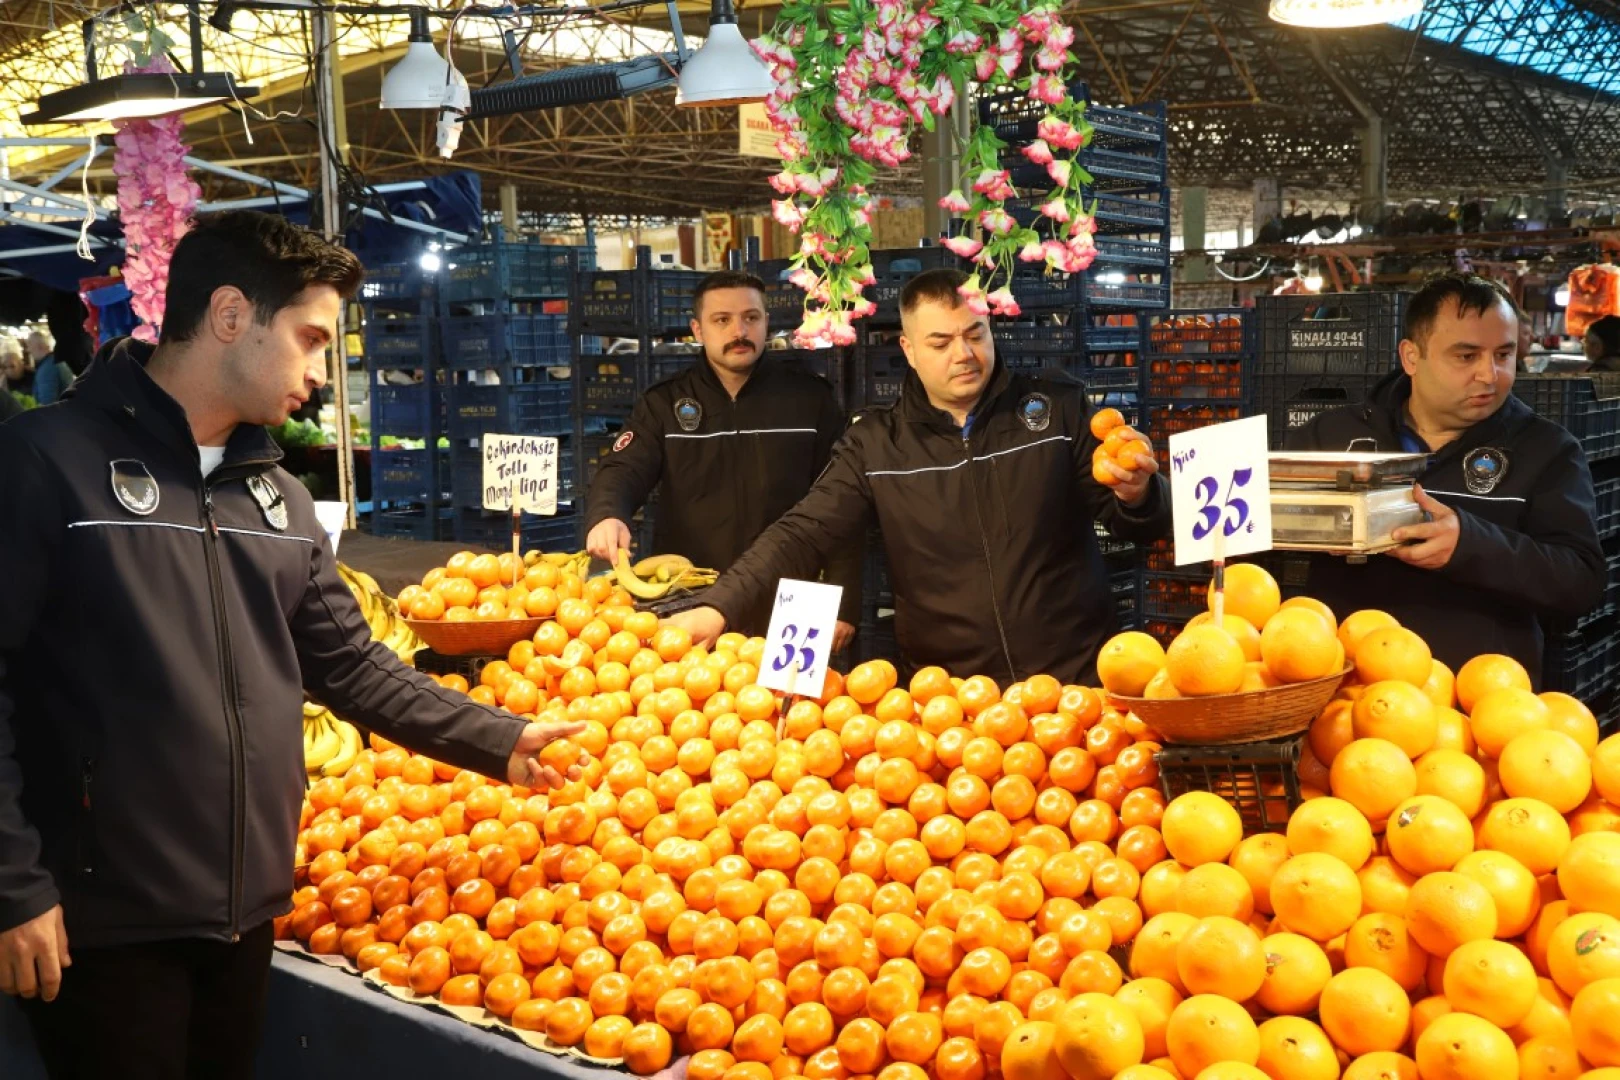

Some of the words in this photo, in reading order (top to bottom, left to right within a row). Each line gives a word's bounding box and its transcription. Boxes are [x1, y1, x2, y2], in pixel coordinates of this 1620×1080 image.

[1333, 331, 1364, 341] 40-41
[486, 477, 549, 507] Mandlina
[1192, 467, 1252, 541] 35
[772, 623, 820, 673] 35
